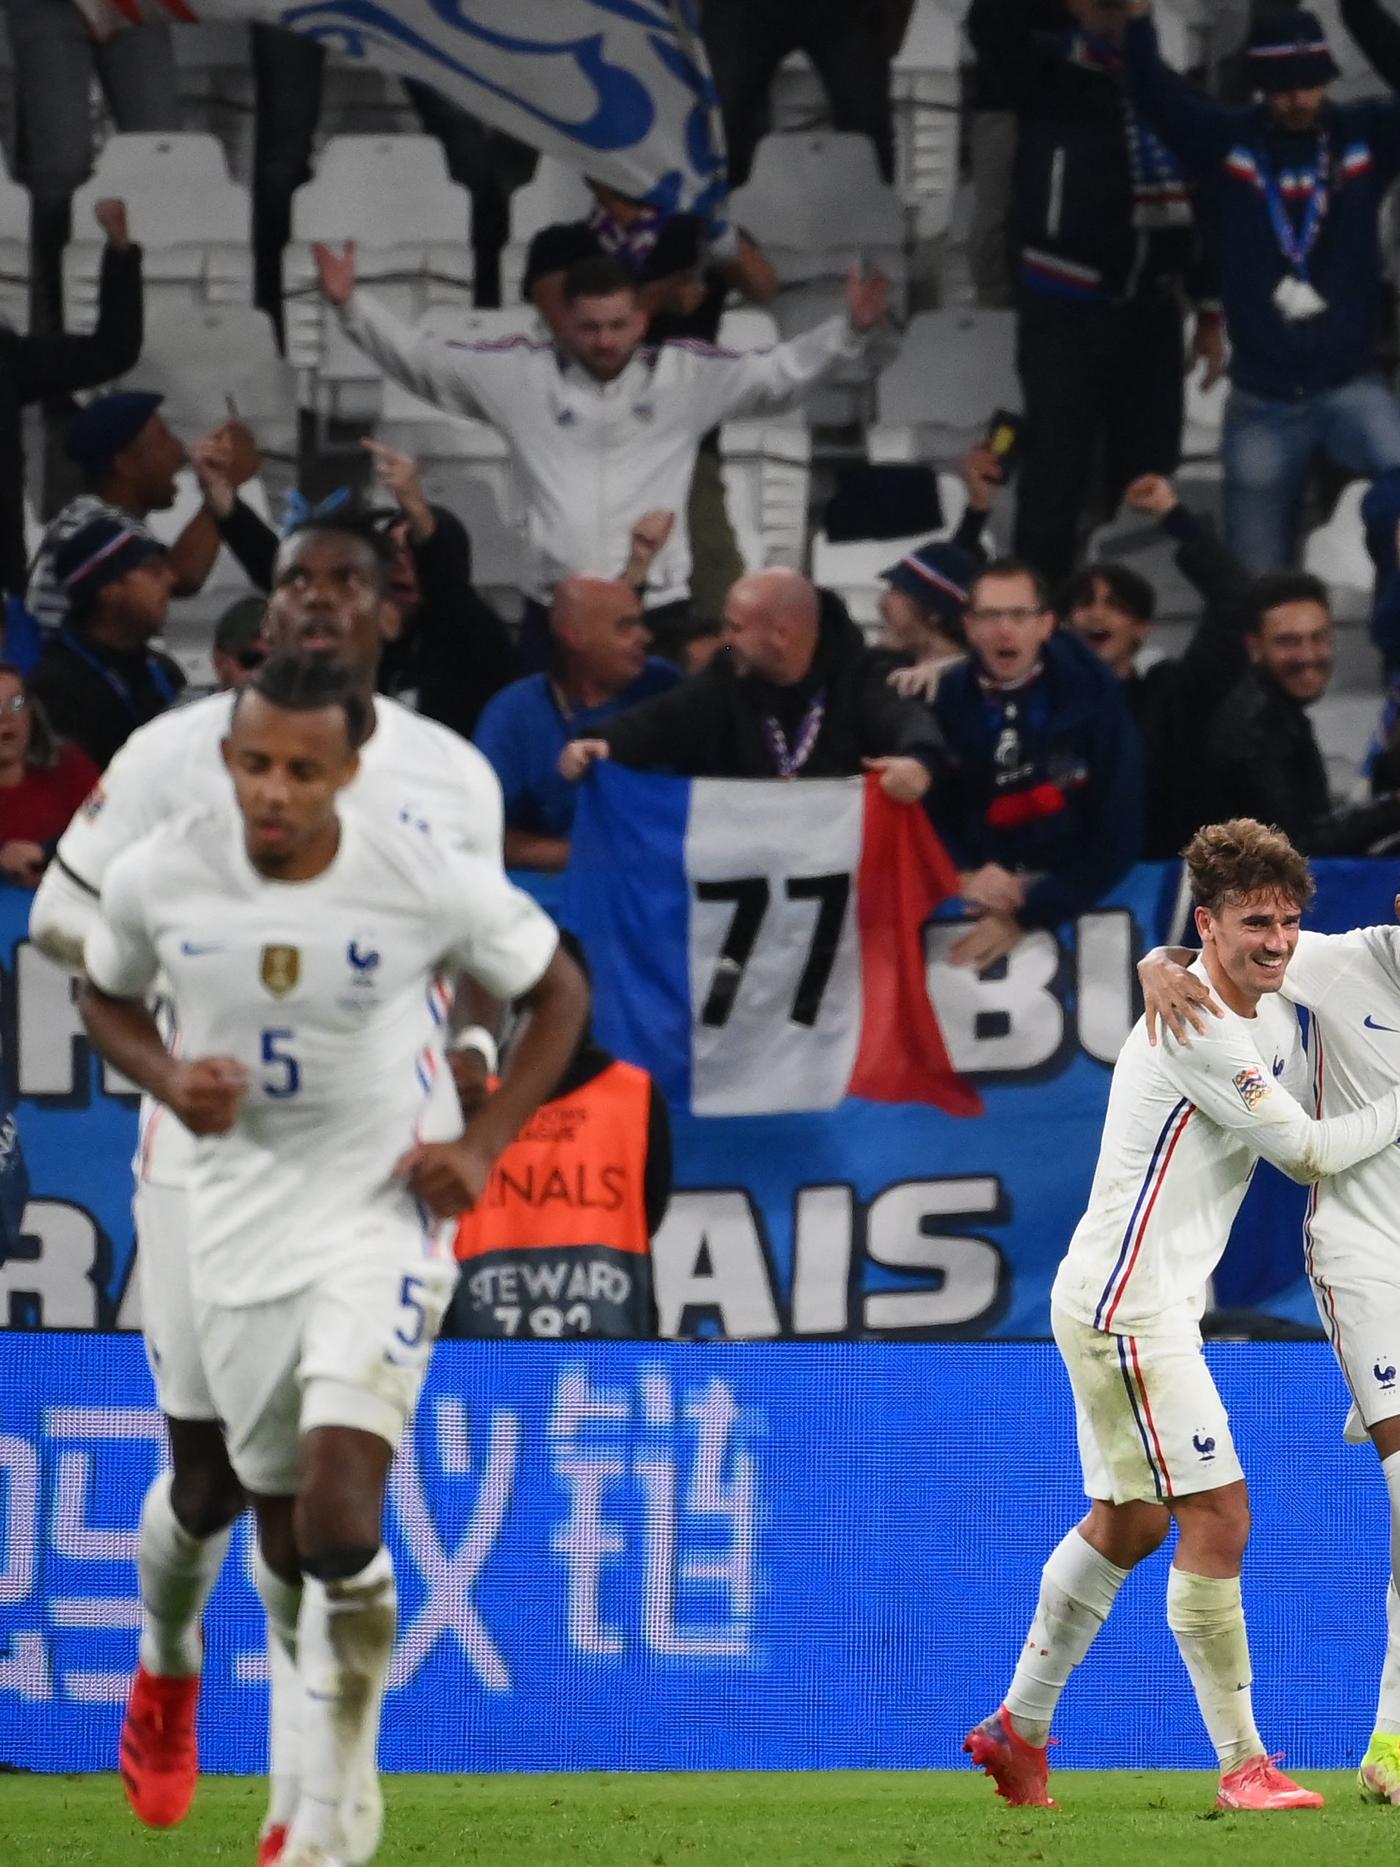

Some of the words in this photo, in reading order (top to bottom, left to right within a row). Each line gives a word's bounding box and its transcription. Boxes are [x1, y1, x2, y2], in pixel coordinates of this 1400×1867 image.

[695, 872, 850, 1028] 77
[262, 1024, 300, 1098] 5
[395, 1276, 426, 1348] 5
[468, 1261, 631, 1310] STEWARD
